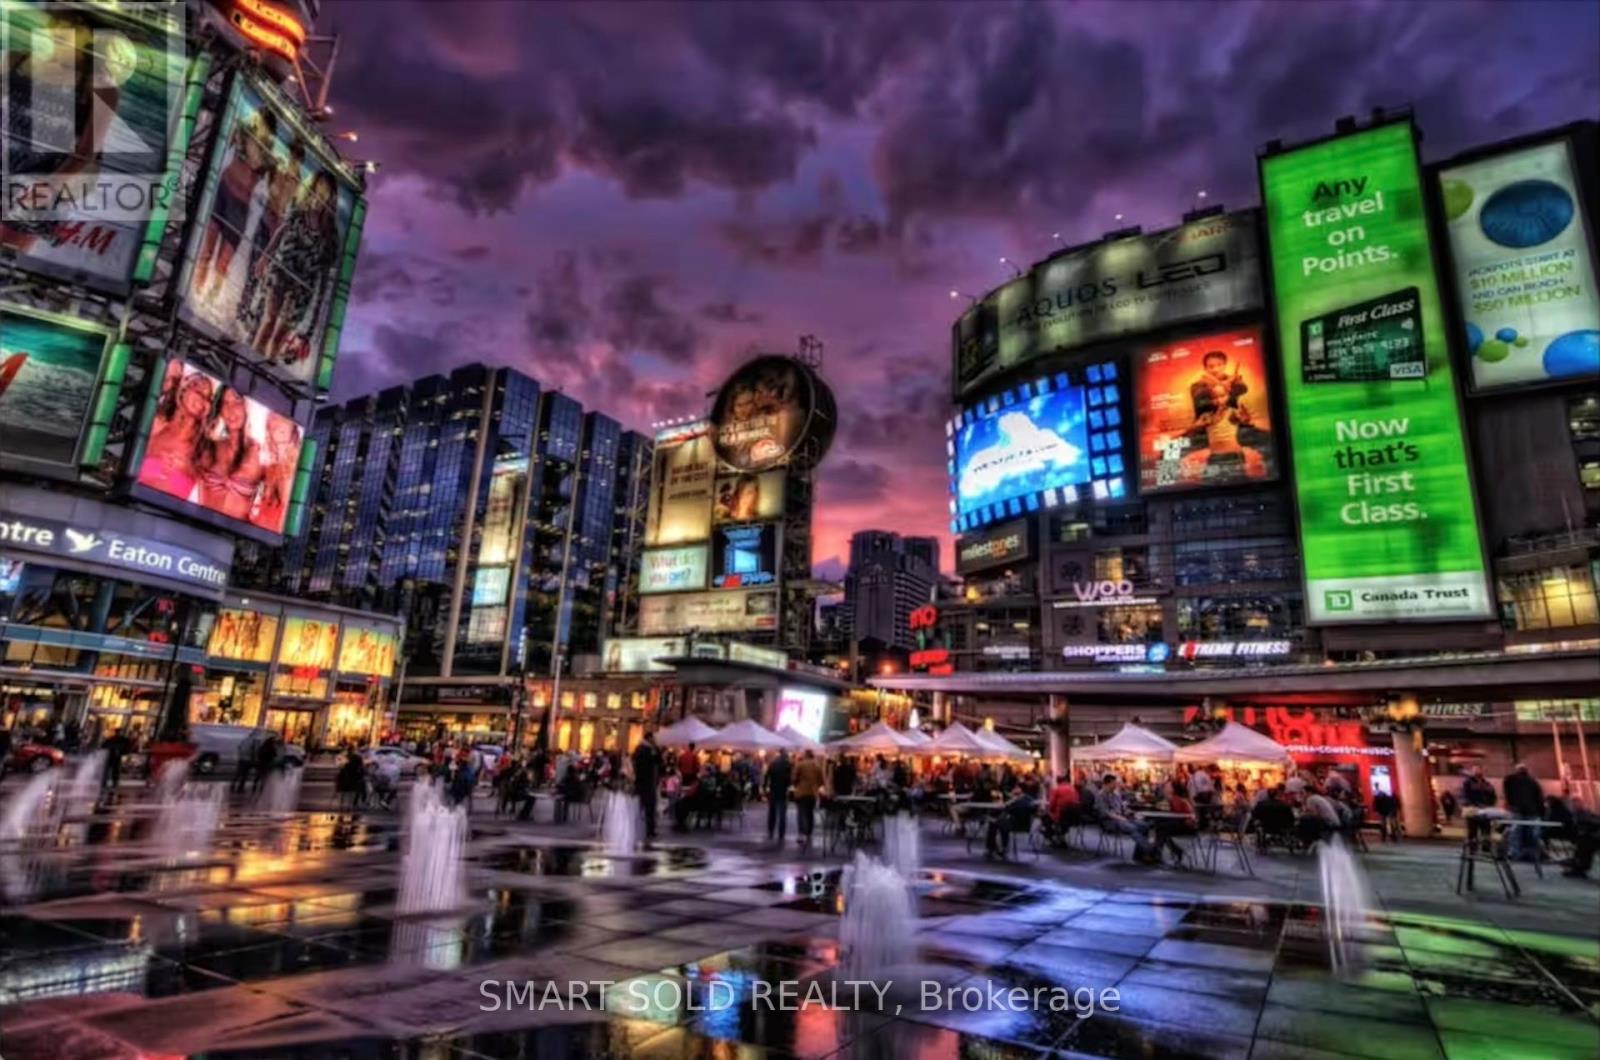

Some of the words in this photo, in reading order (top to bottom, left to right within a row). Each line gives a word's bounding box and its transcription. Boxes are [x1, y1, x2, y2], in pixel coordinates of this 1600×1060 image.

[1311, 175, 1368, 201] Any
[1302, 190, 1385, 228] travel
[1327, 225, 1365, 247] on
[1302, 242, 1398, 277] Points.
[1470, 274, 1498, 290] $10
[1501, 260, 1573, 283] MILLION
[1017, 276, 1118, 324] AQUOS
[1338, 311, 1369, 329] First
[1370, 299, 1415, 320] Class
[1394, 363, 1423, 376] VISA
[1335, 417, 1409, 442] Now
[1333, 442, 1420, 470] that's
[1347, 472, 1415, 496] First
[1340, 501, 1428, 526] Class.
[108, 539, 173, 572] Eaton
[177, 555, 227, 585] Centre
[1325, 591, 1352, 610] TD
[1361, 589, 1419, 603] Canada
[1423, 587, 1470, 600] Trust
[1062, 643, 1146, 657] SHOPPERS
[1236, 640, 1291, 655] FITNESS
